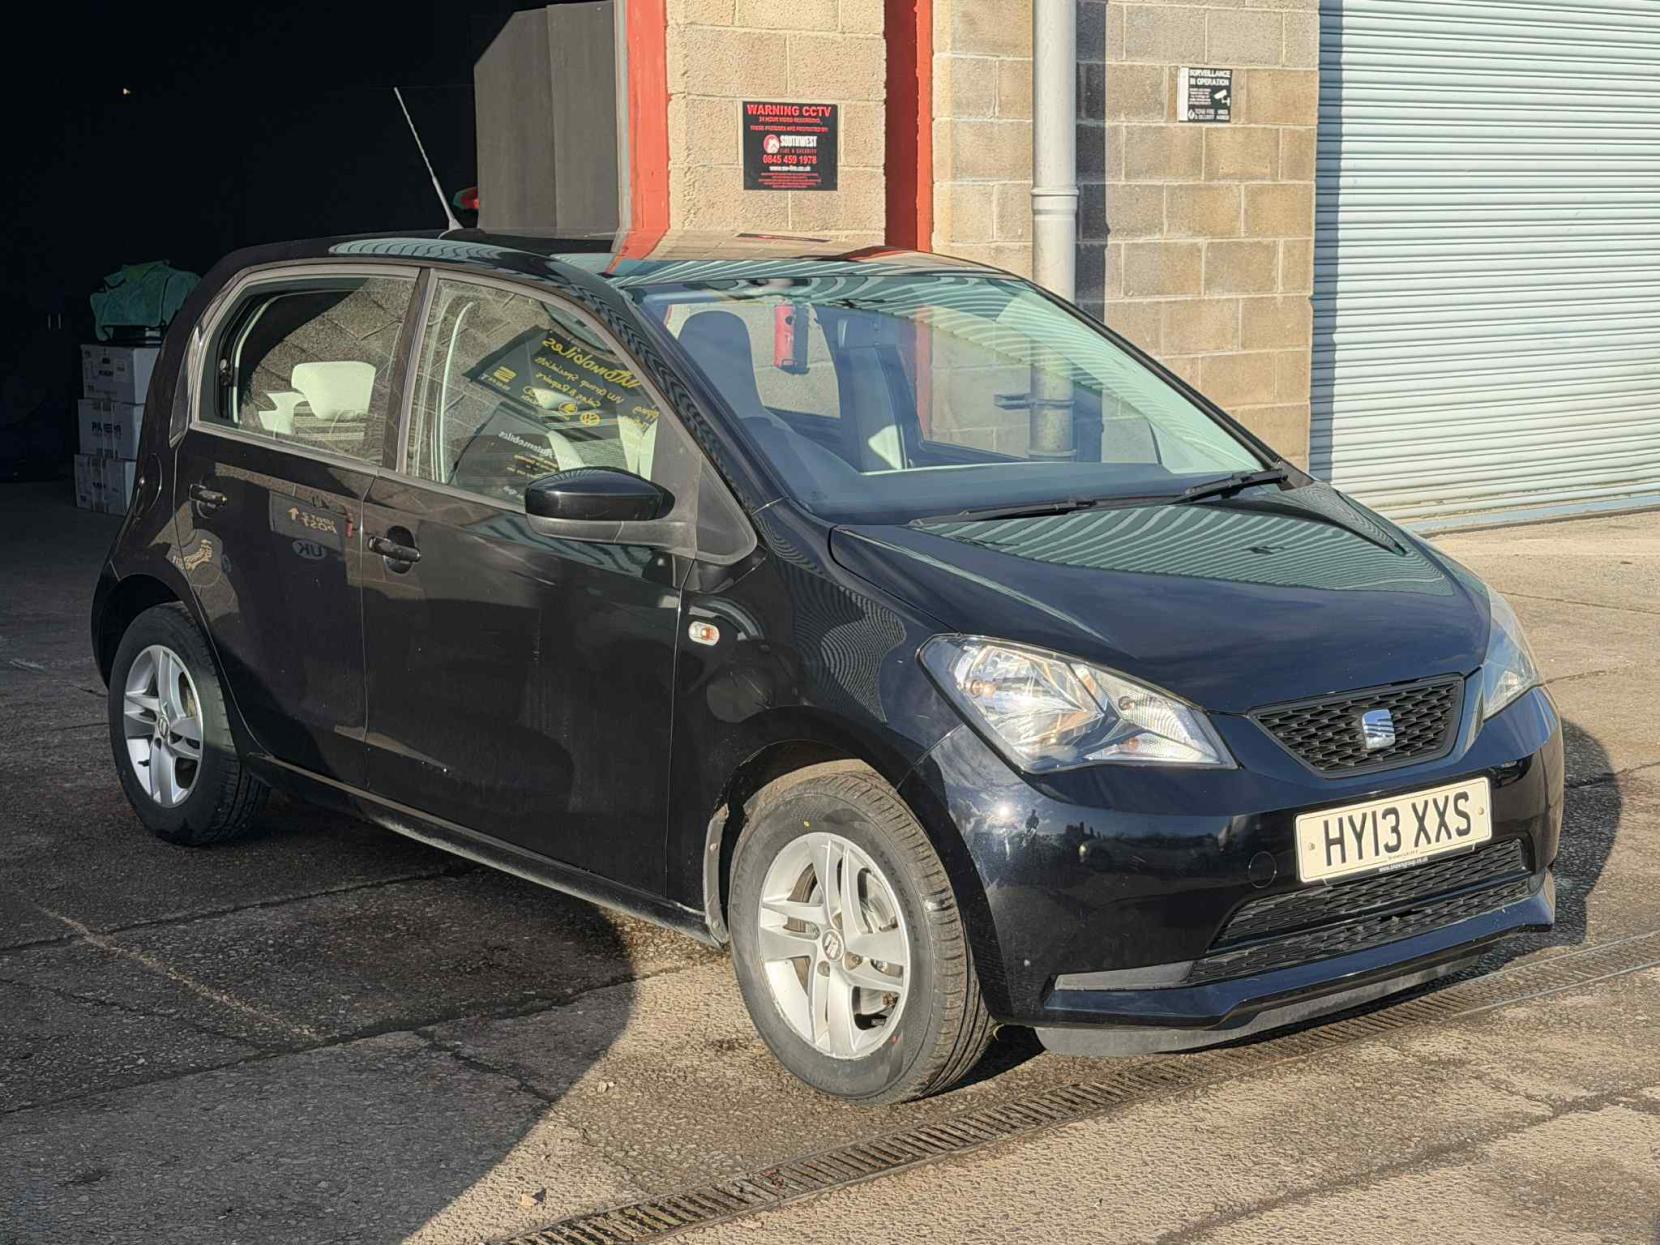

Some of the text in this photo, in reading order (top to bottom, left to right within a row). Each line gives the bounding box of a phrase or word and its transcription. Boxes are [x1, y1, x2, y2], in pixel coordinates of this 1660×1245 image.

[1189, 69, 1231, 78] SURVEILLANCE
[1197, 78, 1230, 86] OPERATION
[746, 104, 832, 117] WARNING CCTV
[780, 135, 817, 148] SOUTHWEST
[762, 154, 817, 165] 0845 459 1978
[1323, 791, 1471, 867] HY13 XXS
